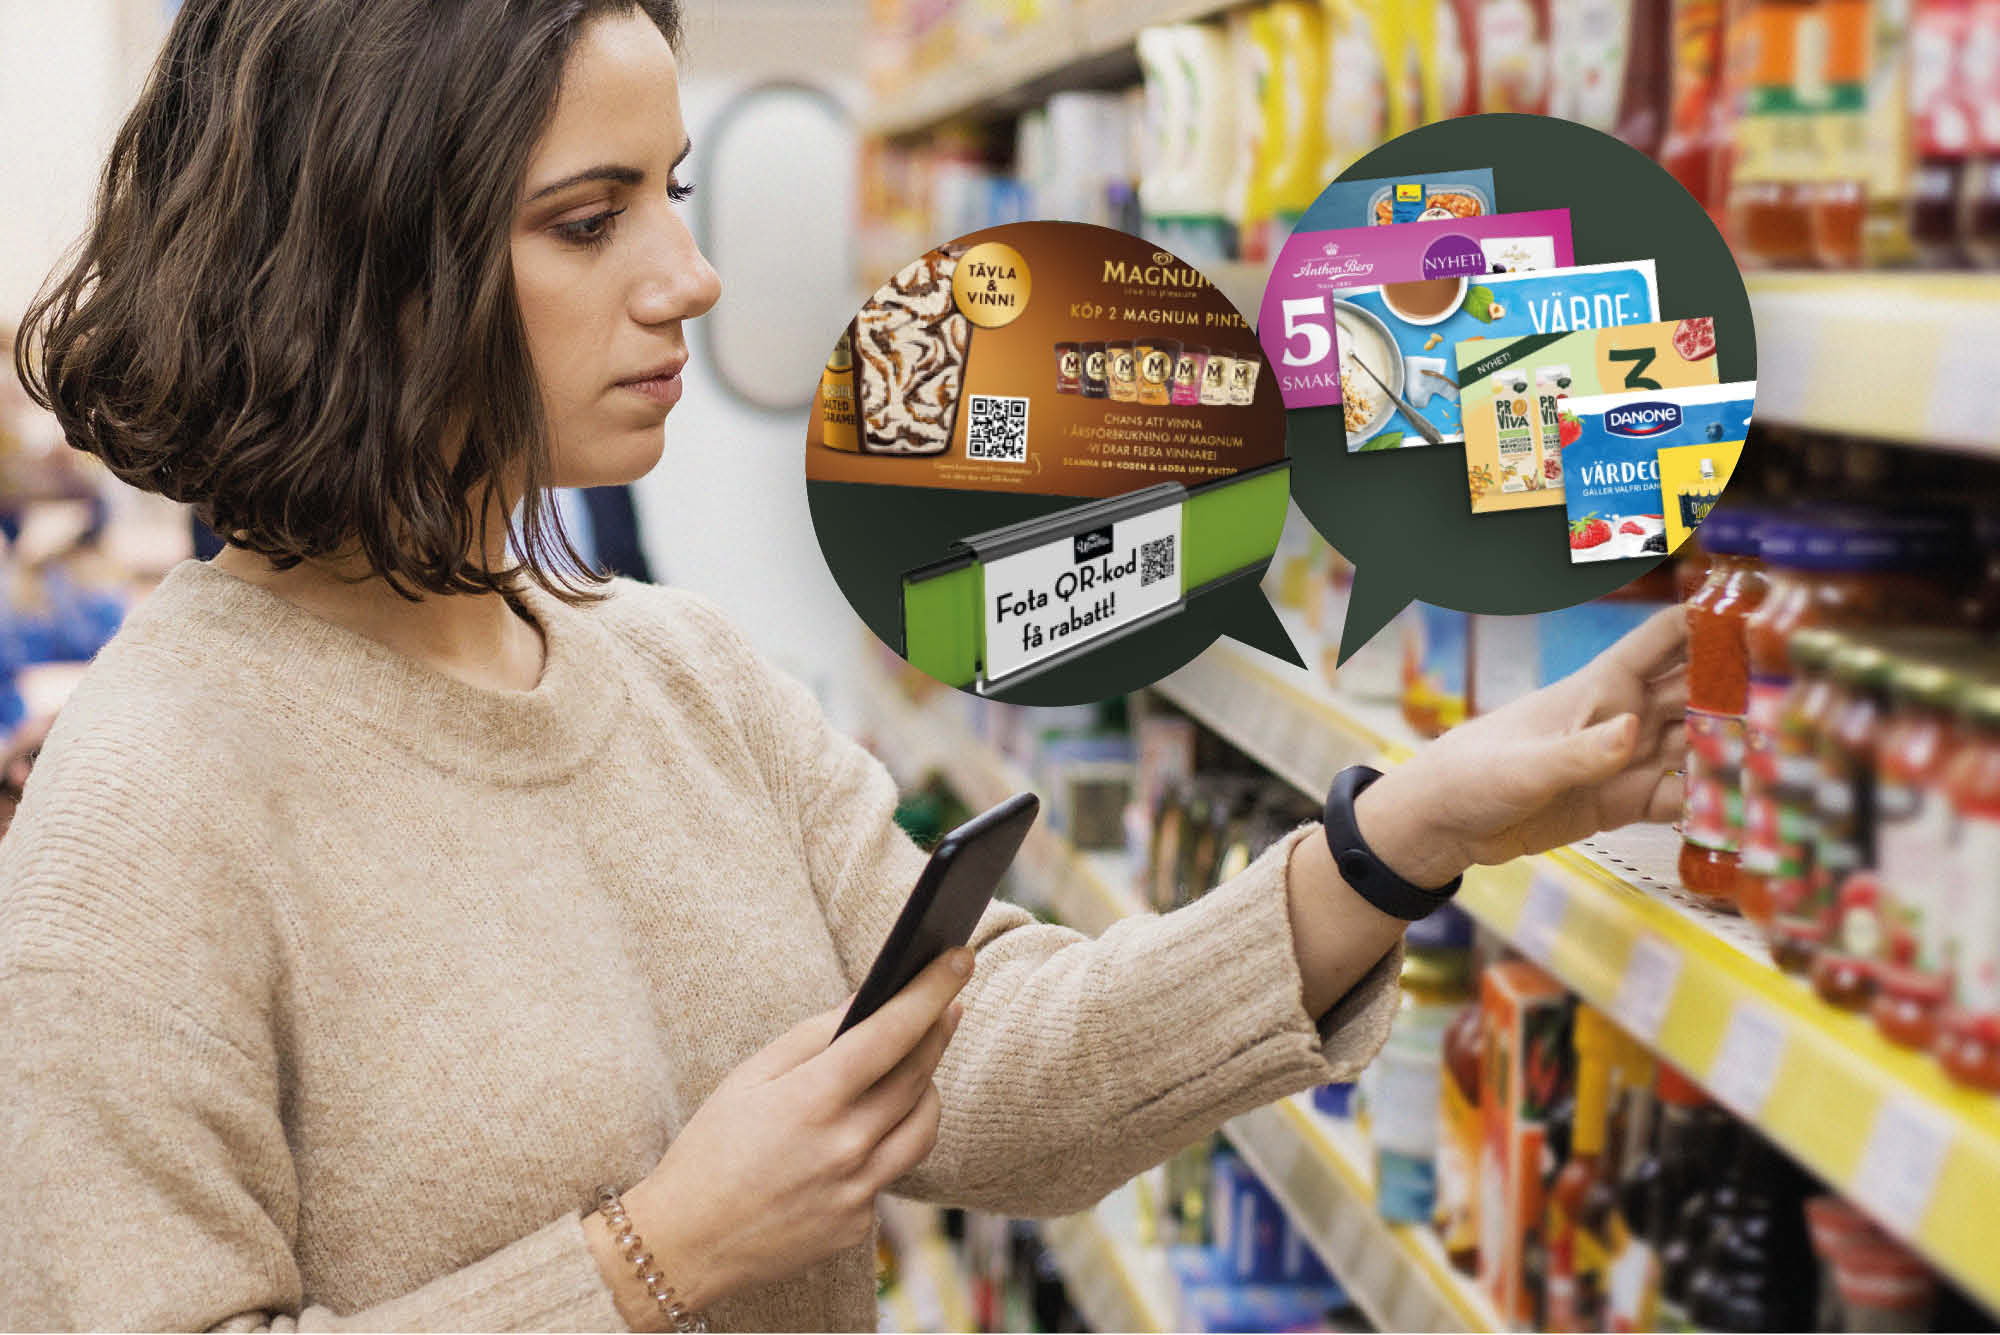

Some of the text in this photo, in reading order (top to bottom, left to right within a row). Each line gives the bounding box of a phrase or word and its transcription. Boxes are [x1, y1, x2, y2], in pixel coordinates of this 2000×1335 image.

[1292, 259, 1375, 278] Anthon Berg
[1425, 253, 1482, 270] NYHET!
[967, 262, 1017, 280] TÄVLA
[986, 279, 998, 292] &
[967, 291, 1015, 307] VINN!
[1070, 301, 1249, 329] KÖP 2 MAGNUM PINTS
[1282, 295, 1331, 367] 5
[1065, 357, 1080, 370] M
[1091, 357, 1106, 370] M
[1119, 358, 1135, 372] M
[1148, 357, 1164, 373] M
[1179, 363, 1193, 376] M
[1207, 364, 1222, 377] M
[1477, 352, 1511, 375] NYHET!
[1608, 347, 1663, 390] 3
[1234, 367, 1248, 380] M
[1104, 413, 1203, 430] CHANS ATT VINNA
[1497, 410, 1529, 430] VIVA
[1173, 433, 1187, 444] AV
[1190, 433, 1244, 449] MAGNUM
[1103, 443, 1130, 456] DRAR
[1133, 445, 1163, 458] FLERA
[1158, 463, 1186, 474] LADDA
[1188, 464, 1205, 474] UPP
[996, 549, 1136, 624] Fota QR-kod
[1022, 592, 1116, 651] få rabatt!
